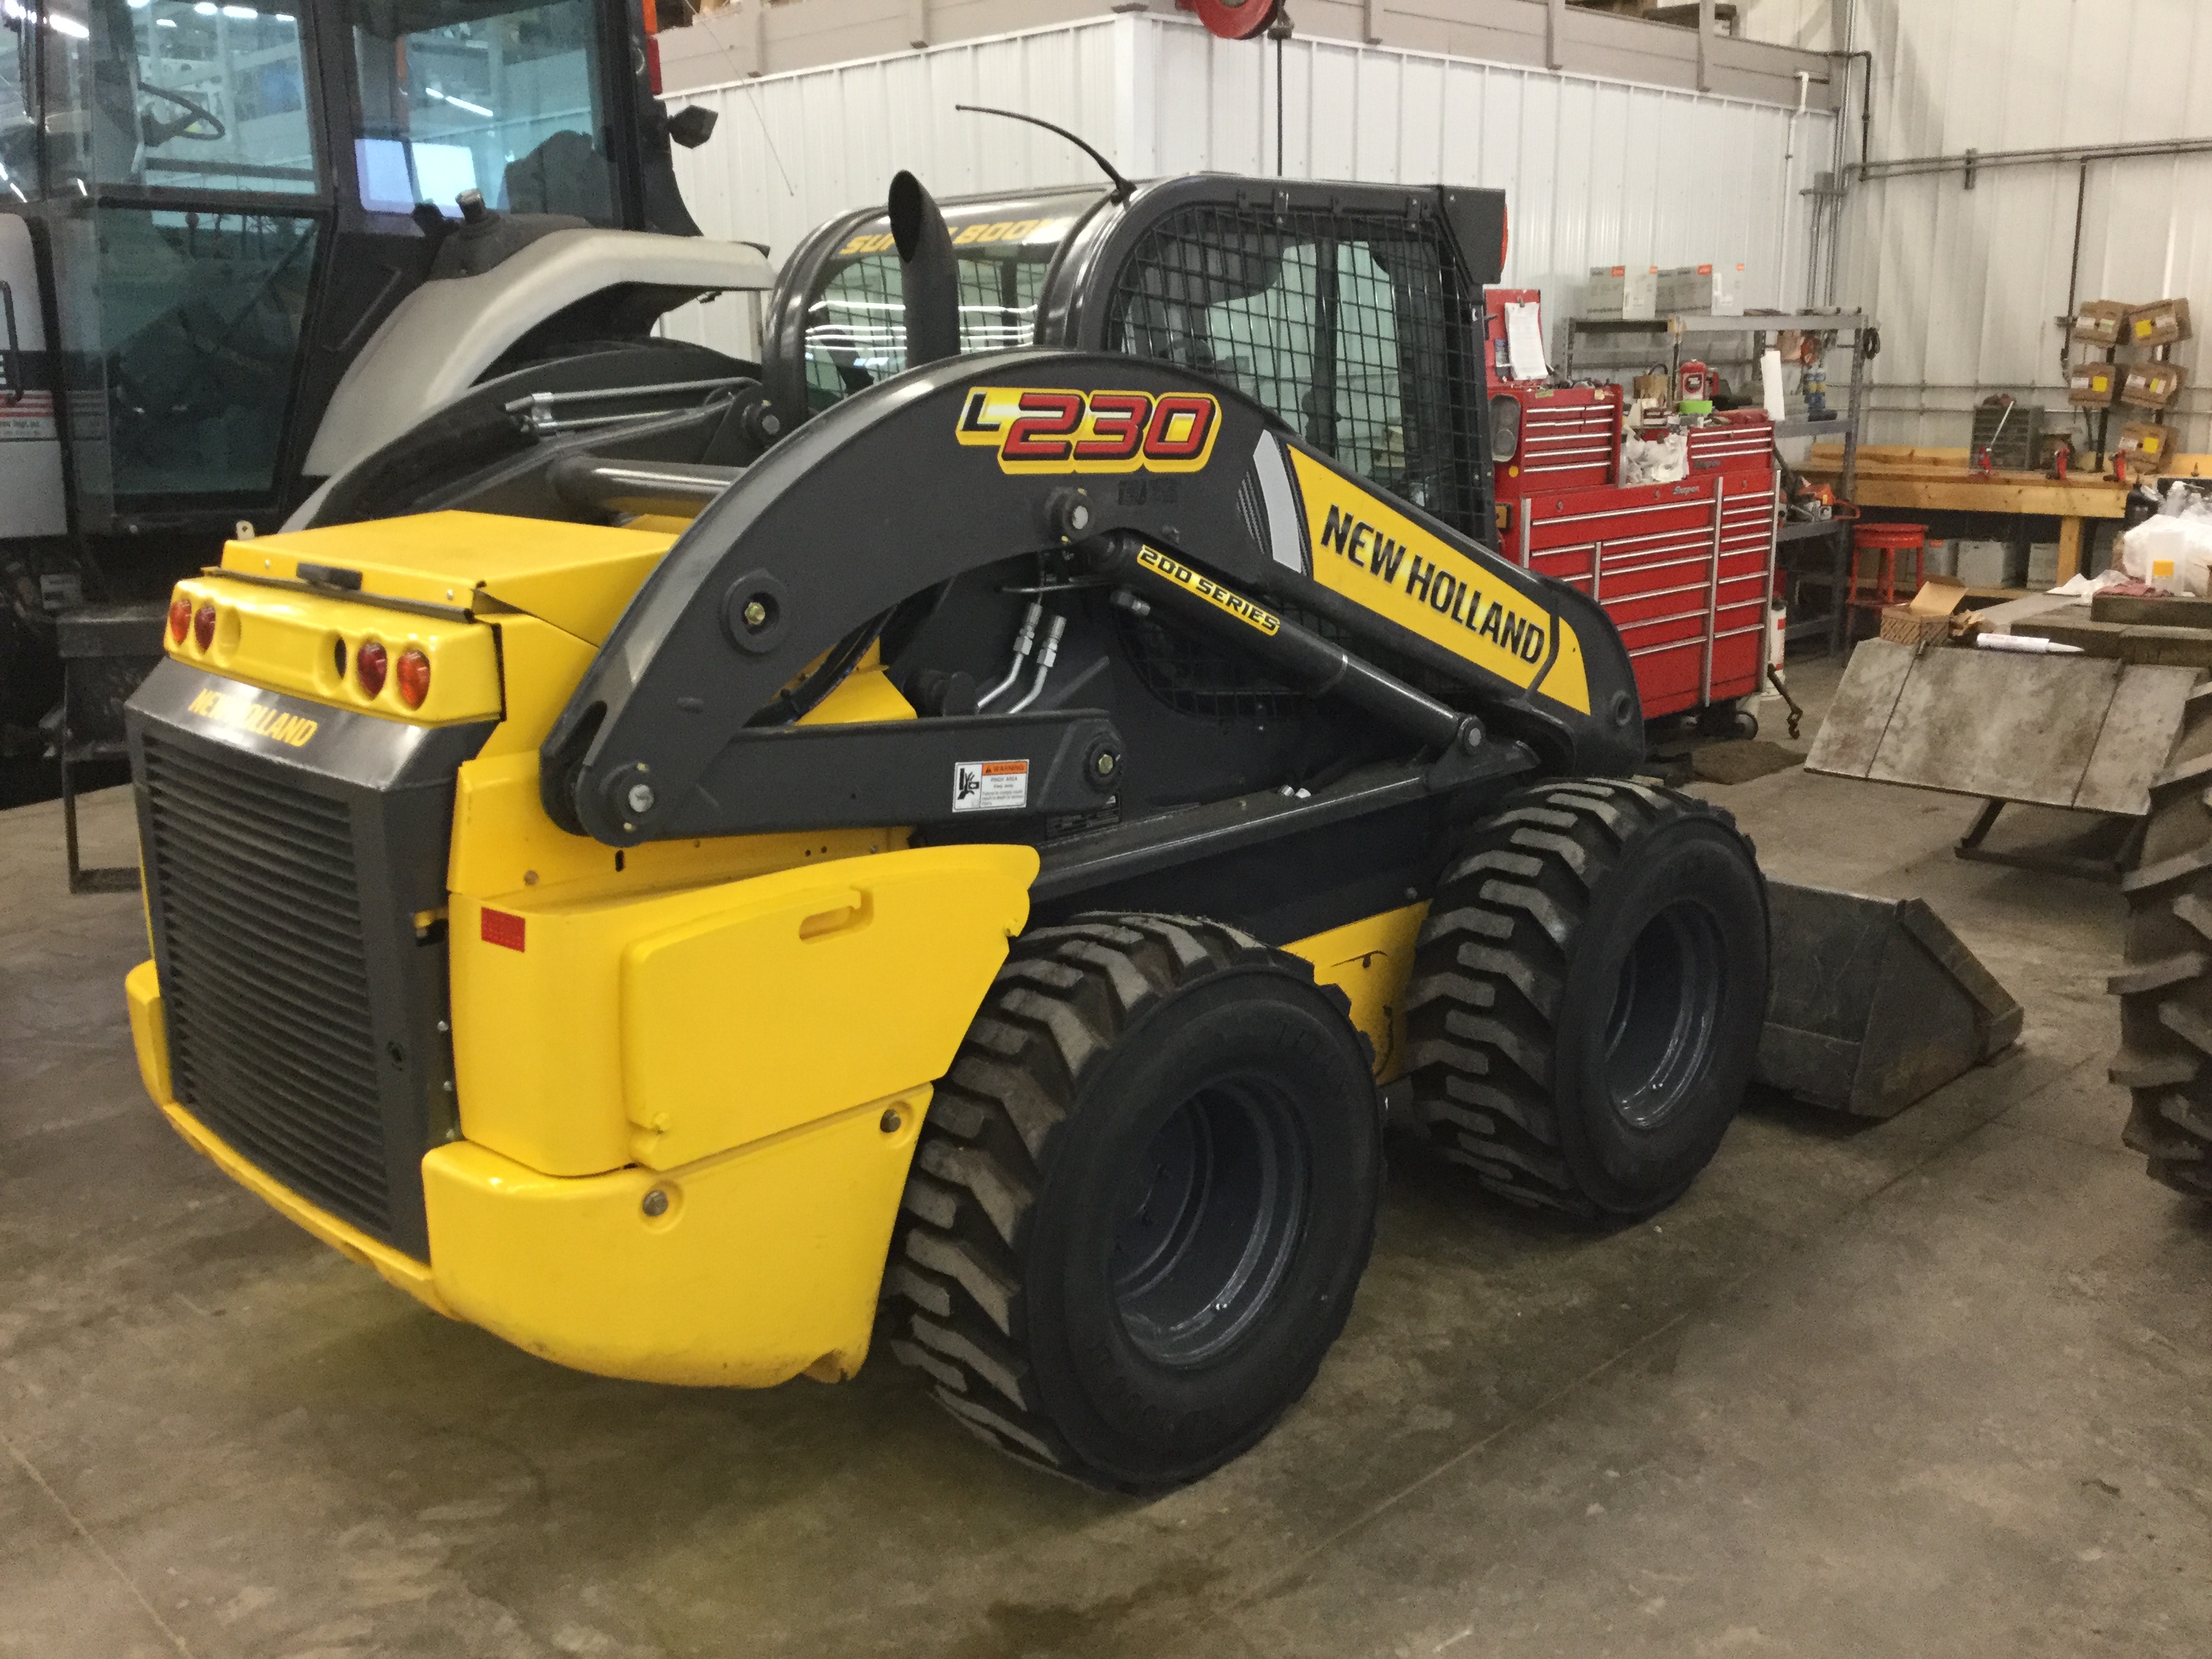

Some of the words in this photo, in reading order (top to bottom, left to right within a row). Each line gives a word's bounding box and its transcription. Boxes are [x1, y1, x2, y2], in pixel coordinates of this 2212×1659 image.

[958, 390, 1218, 465] L230
[1141, 550, 1192, 583] 200
[1195, 577, 1279, 631] SERIES
[1320, 504, 1407, 585] NEW
[1404, 552, 1545, 665] HOLLAND
